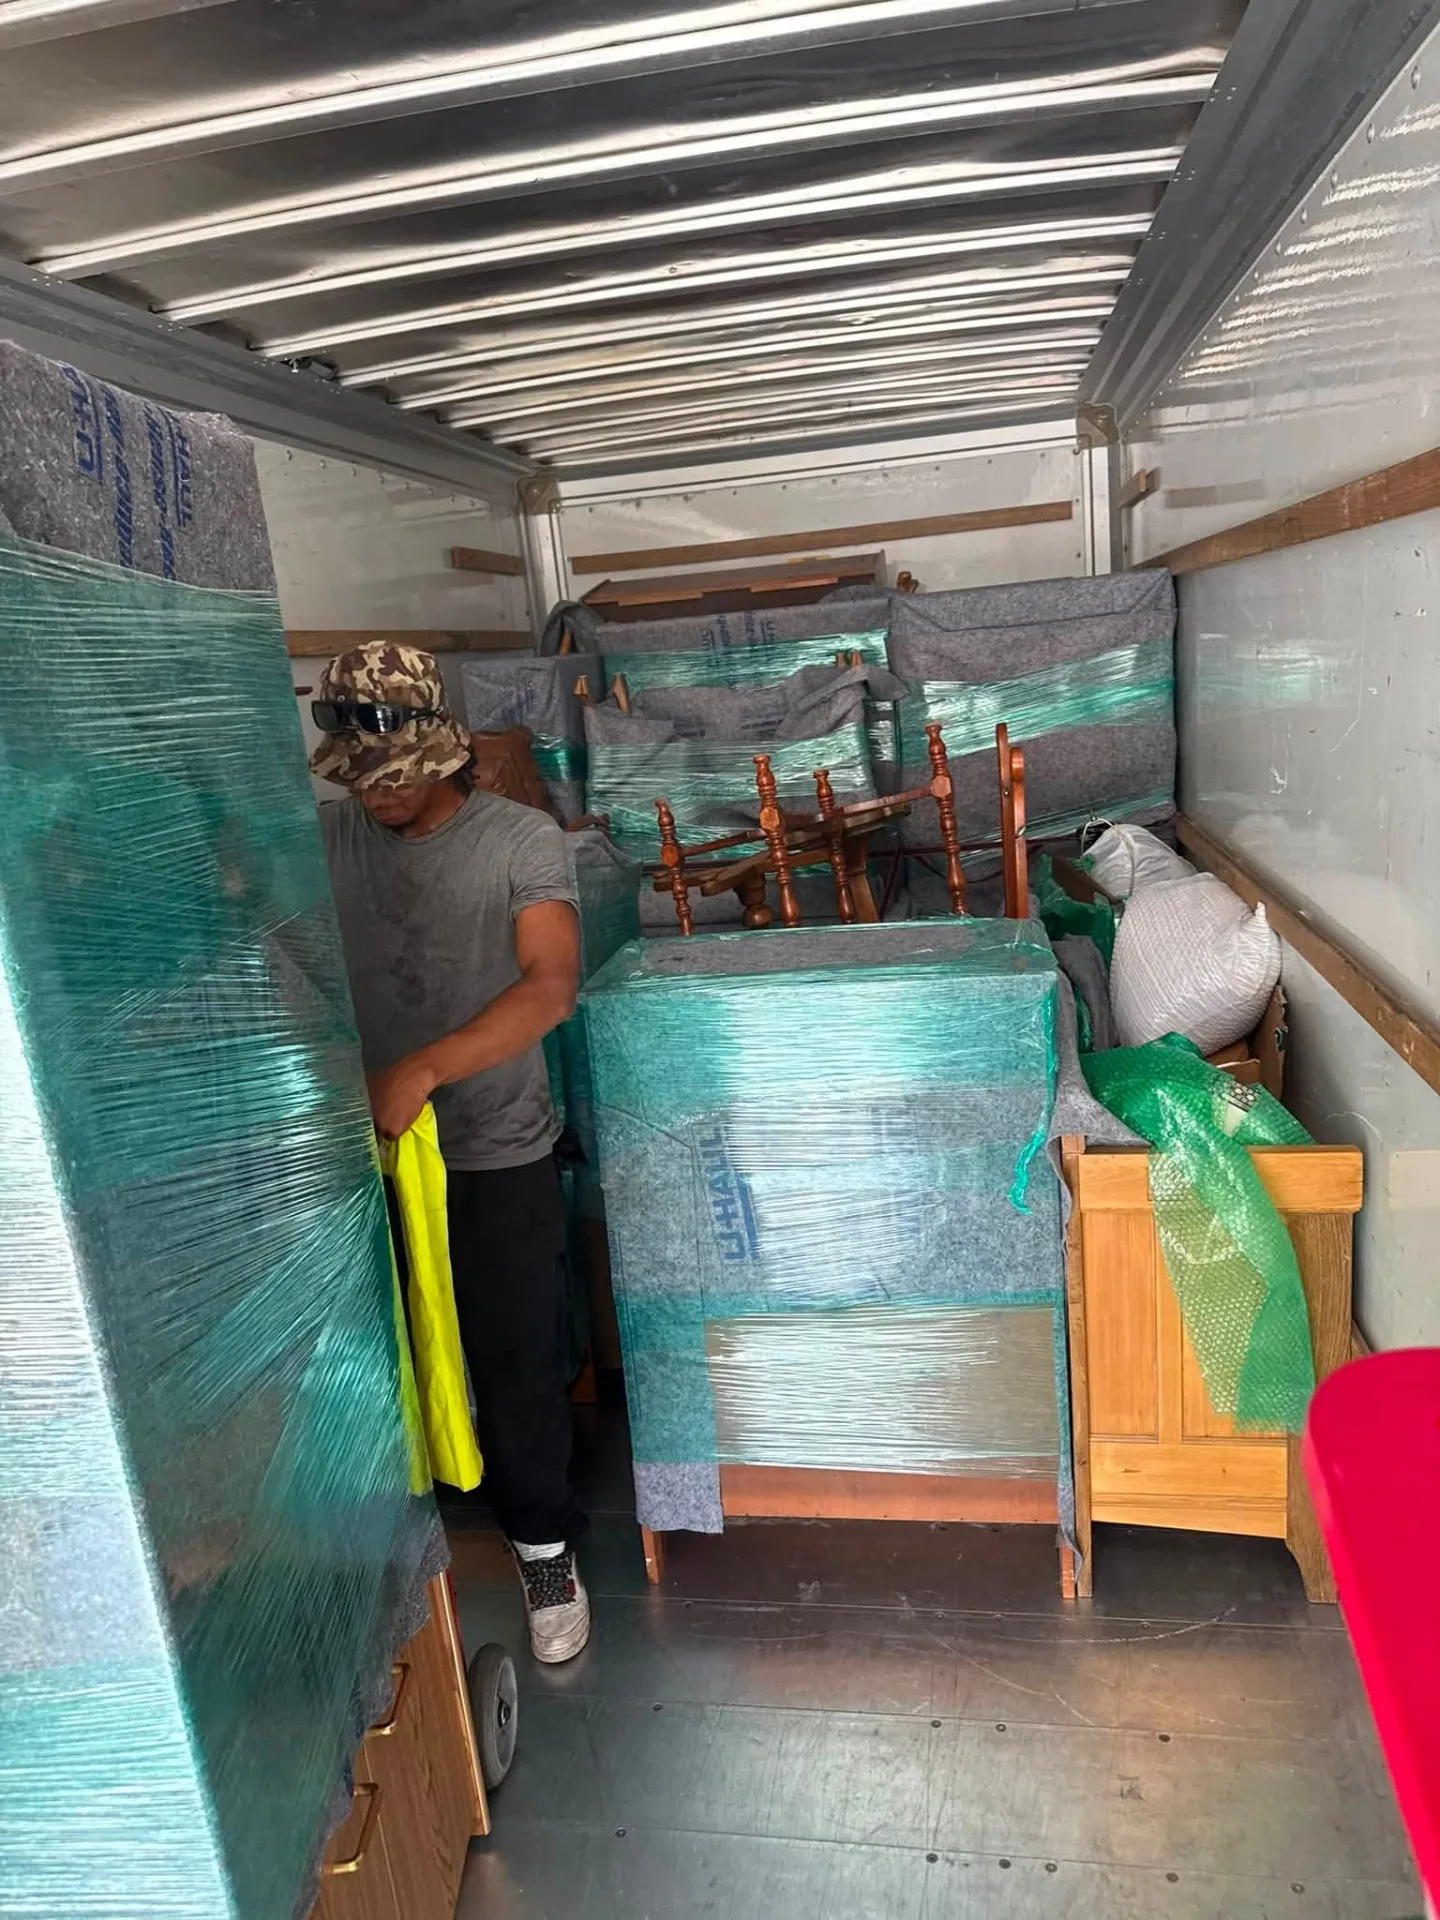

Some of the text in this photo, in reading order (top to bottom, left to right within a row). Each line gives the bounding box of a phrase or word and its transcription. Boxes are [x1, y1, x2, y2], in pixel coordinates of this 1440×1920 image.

[62, 366, 95, 472] U-HA
[168, 411, 193, 527] -HAUL
[699, 1126, 746, 1261] U-HAUL
